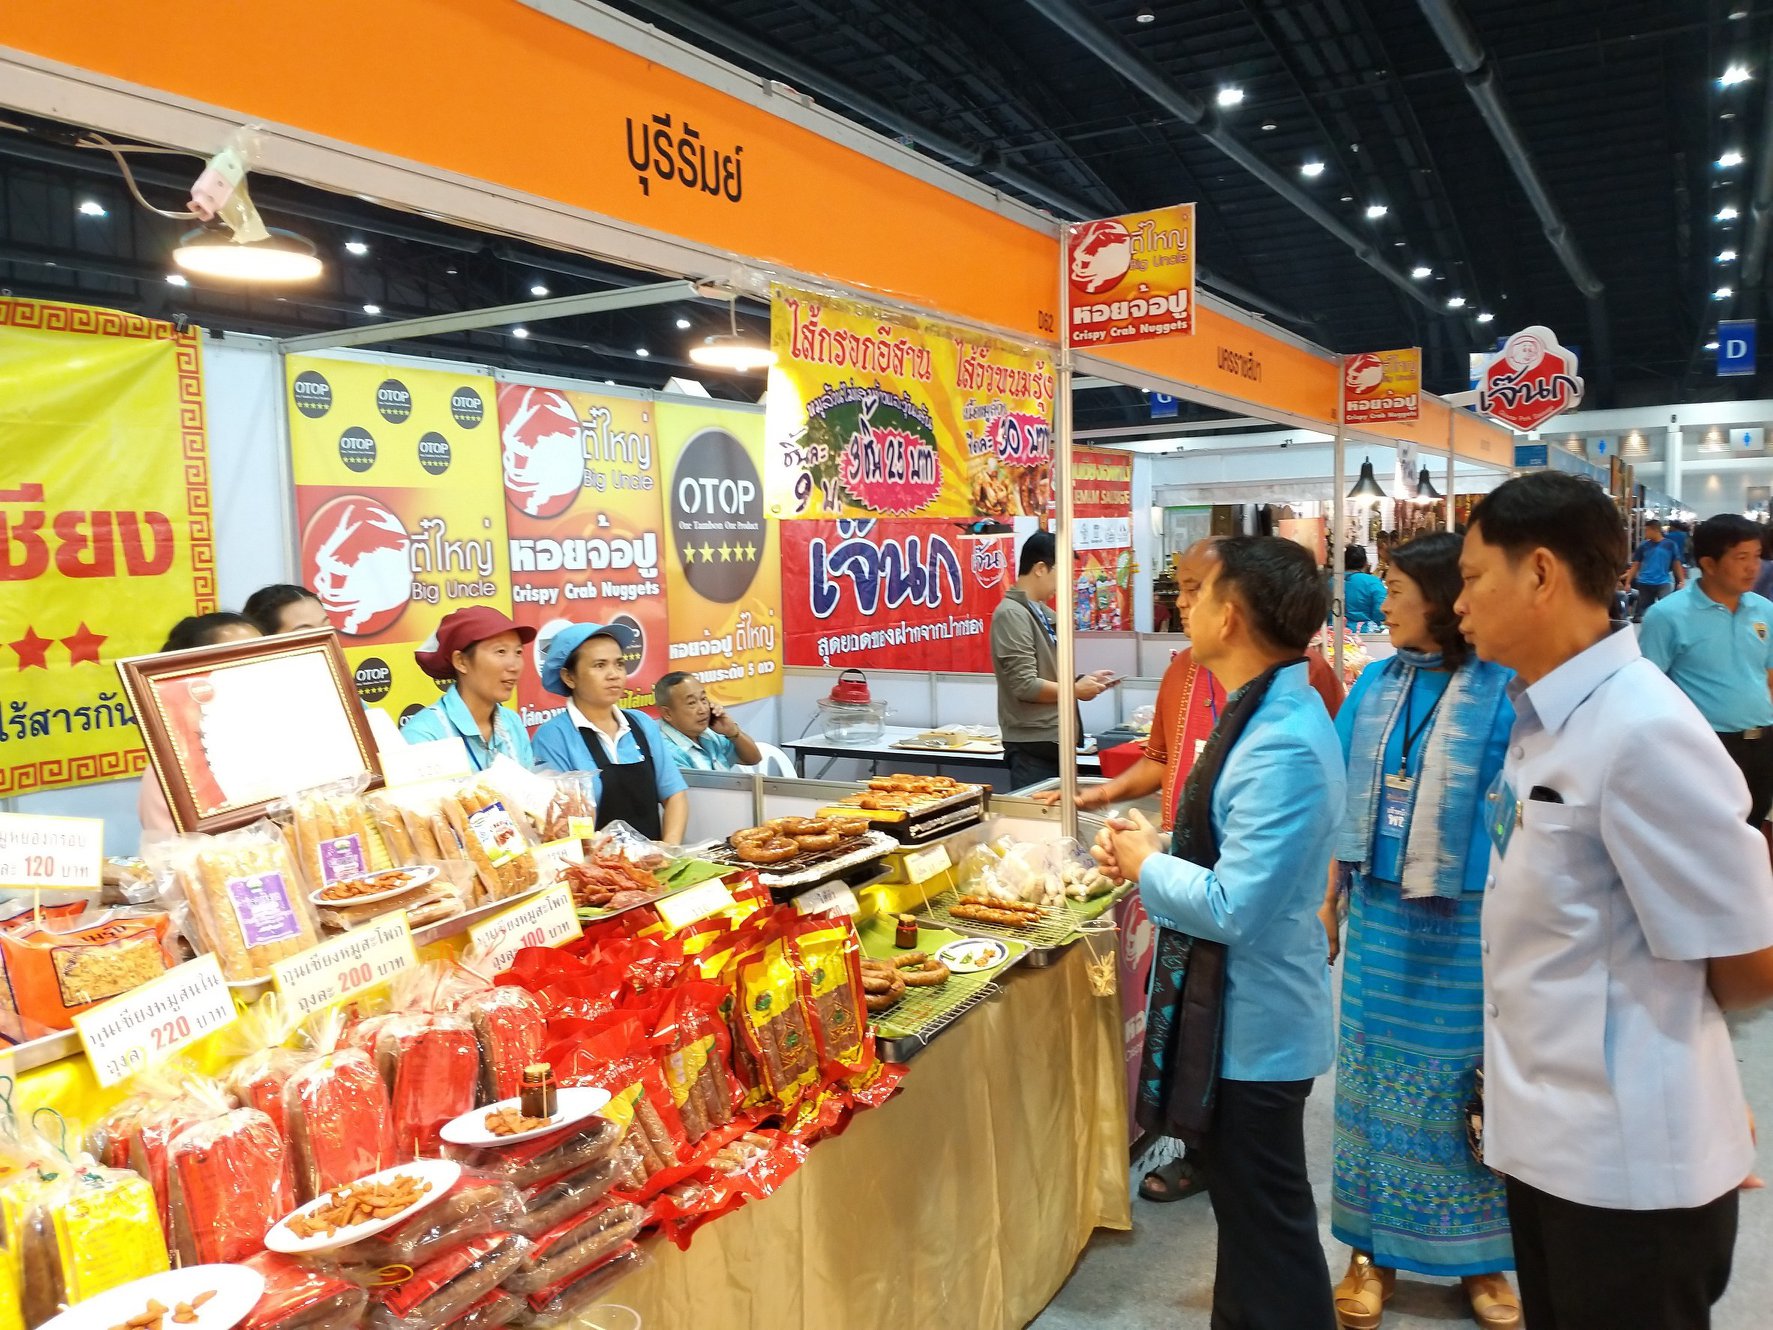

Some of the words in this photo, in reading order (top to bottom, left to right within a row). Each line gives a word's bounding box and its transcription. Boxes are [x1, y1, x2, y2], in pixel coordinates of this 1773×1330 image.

[626, 113, 744, 203] บุรีรัมย์
[1072, 330, 1107, 342] Crispy
[1110, 325, 1136, 337] Crab
[1139, 320, 1188, 335] Nuggets
[1726, 339, 1748, 359] D
[295, 381, 330, 396] OTOP
[378, 389, 410, 402] OTOP
[1480, 364, 1578, 412] เจ๊นก
[452, 396, 481, 409] OTOP
[340, 437, 374, 450] OTOP
[419, 442, 448, 455] OTOP
[583, 405, 652, 471] ตี๋ใหญ่
[584, 469, 606, 492] Big
[613, 468, 654, 490] Uncle
[678, 476, 756, 515] OTOP
[794, 472, 812, 513] 9
[410, 517, 494, 576] ตี๋ใหญ่
[411, 581, 440, 604] Big
[446, 580, 496, 598] Uncle
[512, 582, 559, 604] Crispy
[564, 580, 597, 600] Crab
[601, 580, 660, 601] Nuggets
[356, 668, 390, 681] OTOP
[24, 855, 55, 877] 120
[61, 865, 89, 878] บาท
[520, 927, 546, 949] 100
[548, 921, 571, 939] บาท
[338, 962, 373, 993] 200
[377, 956, 405, 976] บาท
[150, 1015, 192, 1051] 220
[196, 1005, 228, 1029] บาท
